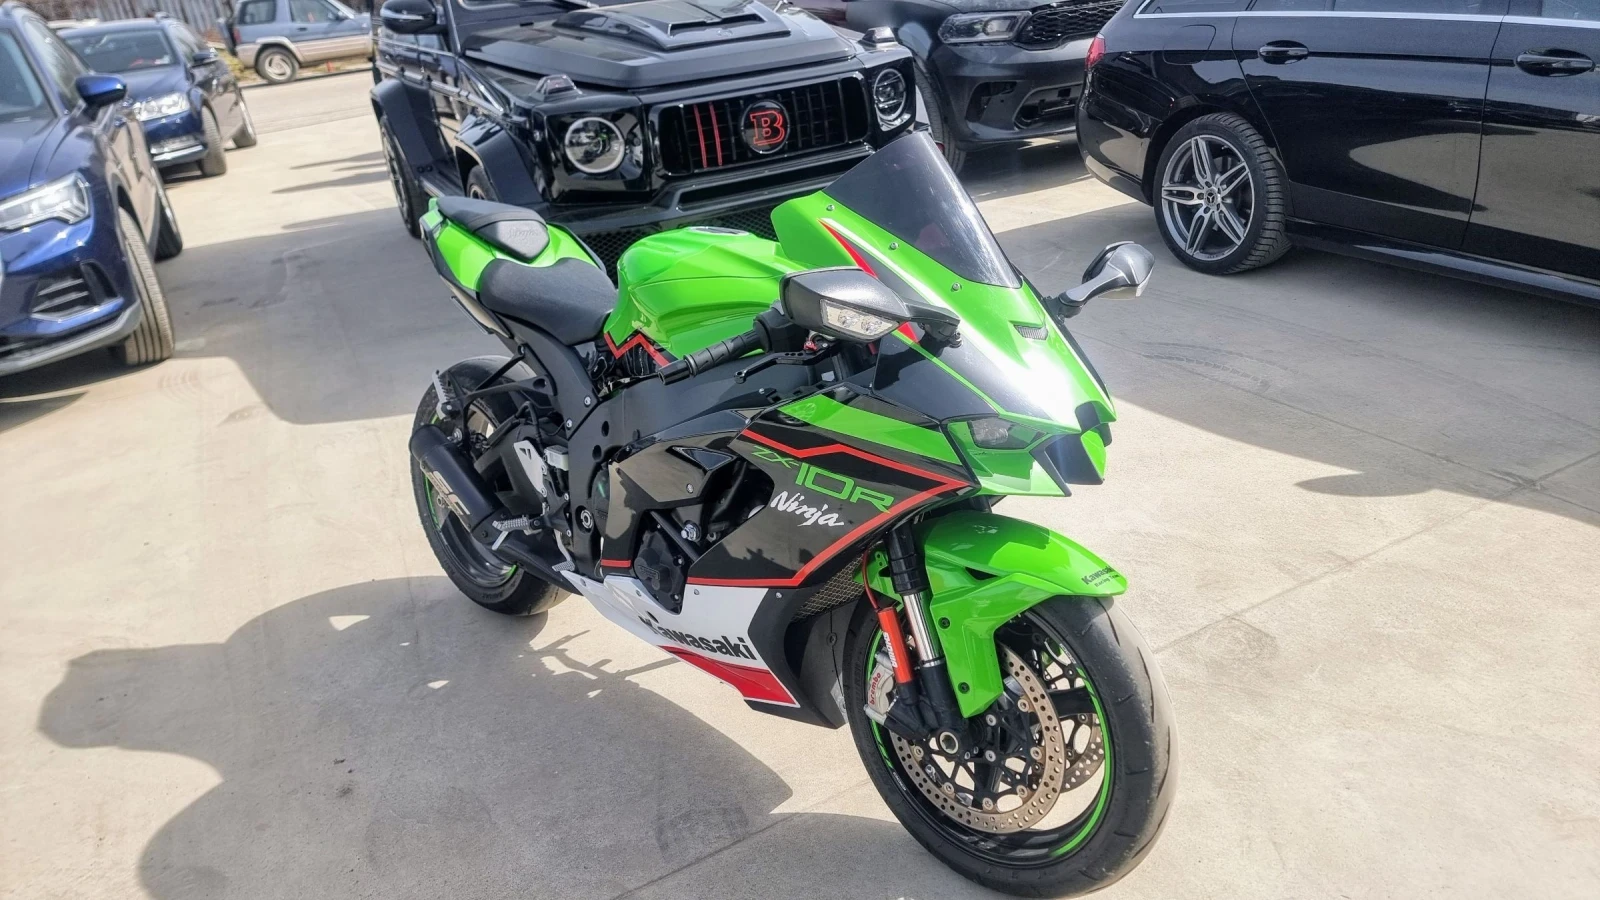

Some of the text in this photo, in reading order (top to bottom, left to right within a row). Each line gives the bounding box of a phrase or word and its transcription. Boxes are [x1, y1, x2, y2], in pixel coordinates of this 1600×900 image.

[749, 109, 786, 146] B
[770, 491, 845, 527] Ninja
[638, 611, 757, 660] Kawasaki
[869, 672, 881, 705] brembo
